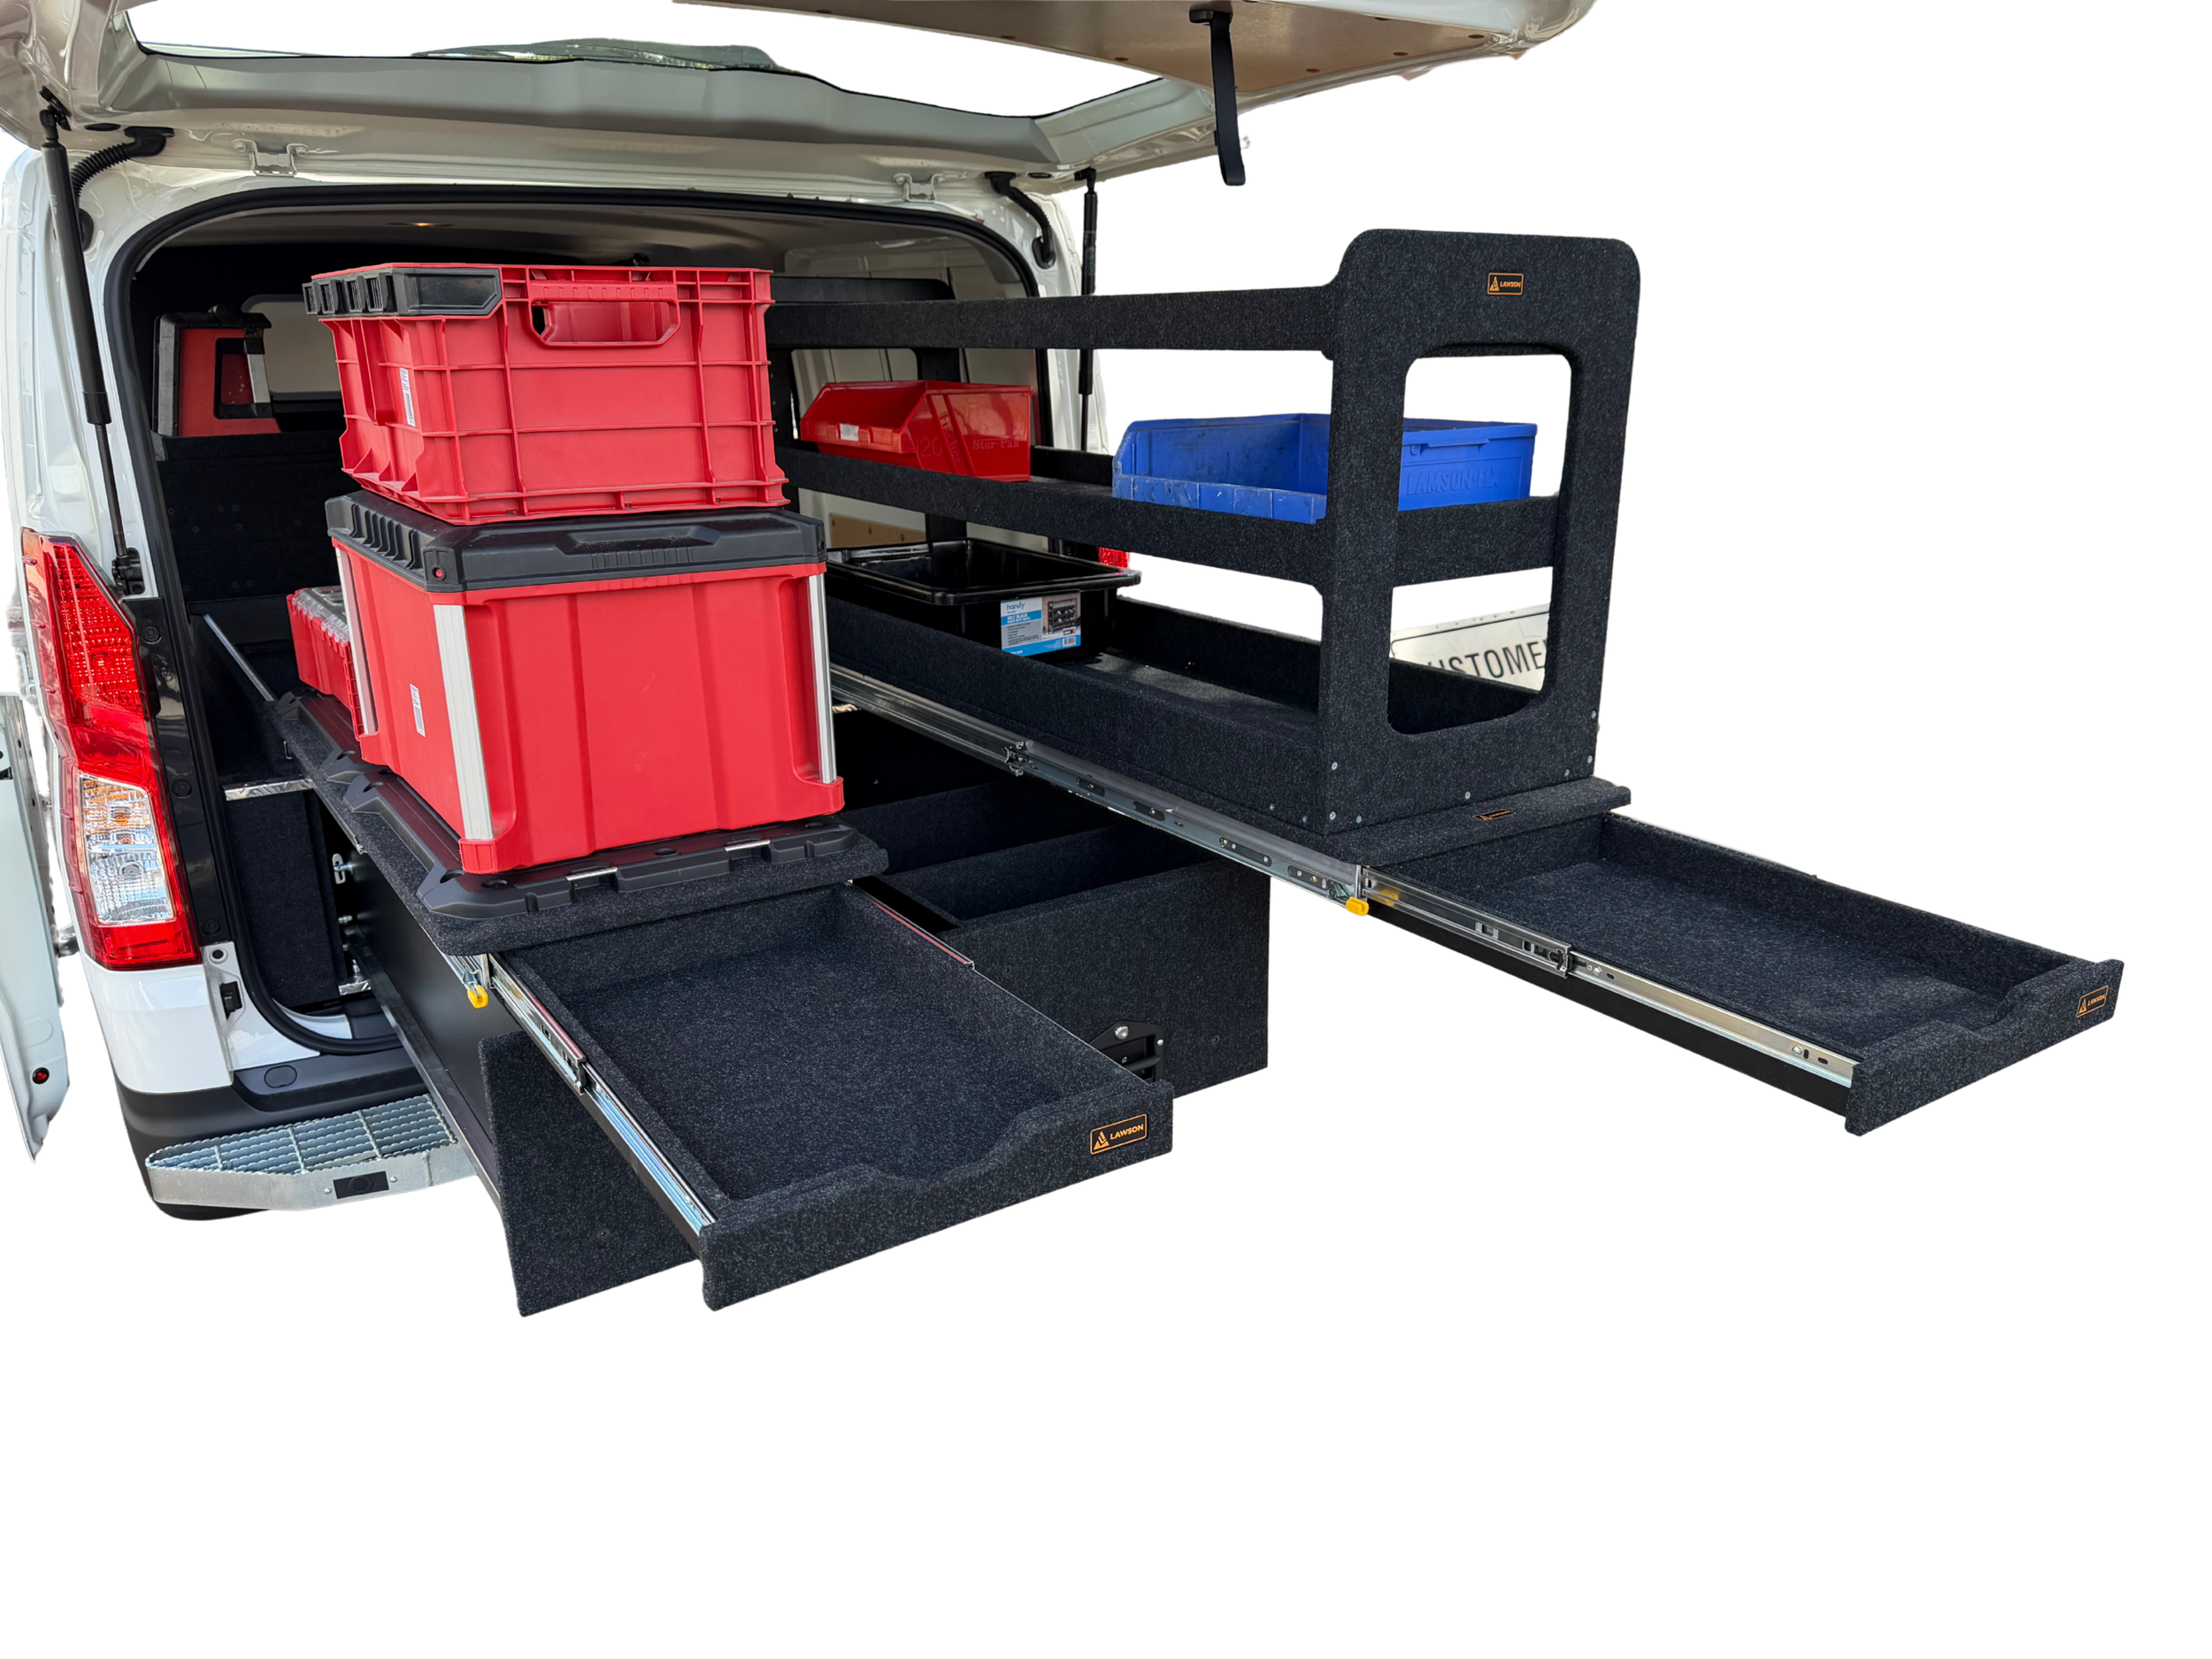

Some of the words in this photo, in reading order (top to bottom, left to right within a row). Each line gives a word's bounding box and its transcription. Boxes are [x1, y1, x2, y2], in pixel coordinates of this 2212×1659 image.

[1006, 601, 1025, 611] handy
[1427, 639, 1548, 679] STOME
[1110, 1124, 1144, 1141] LAWSON
